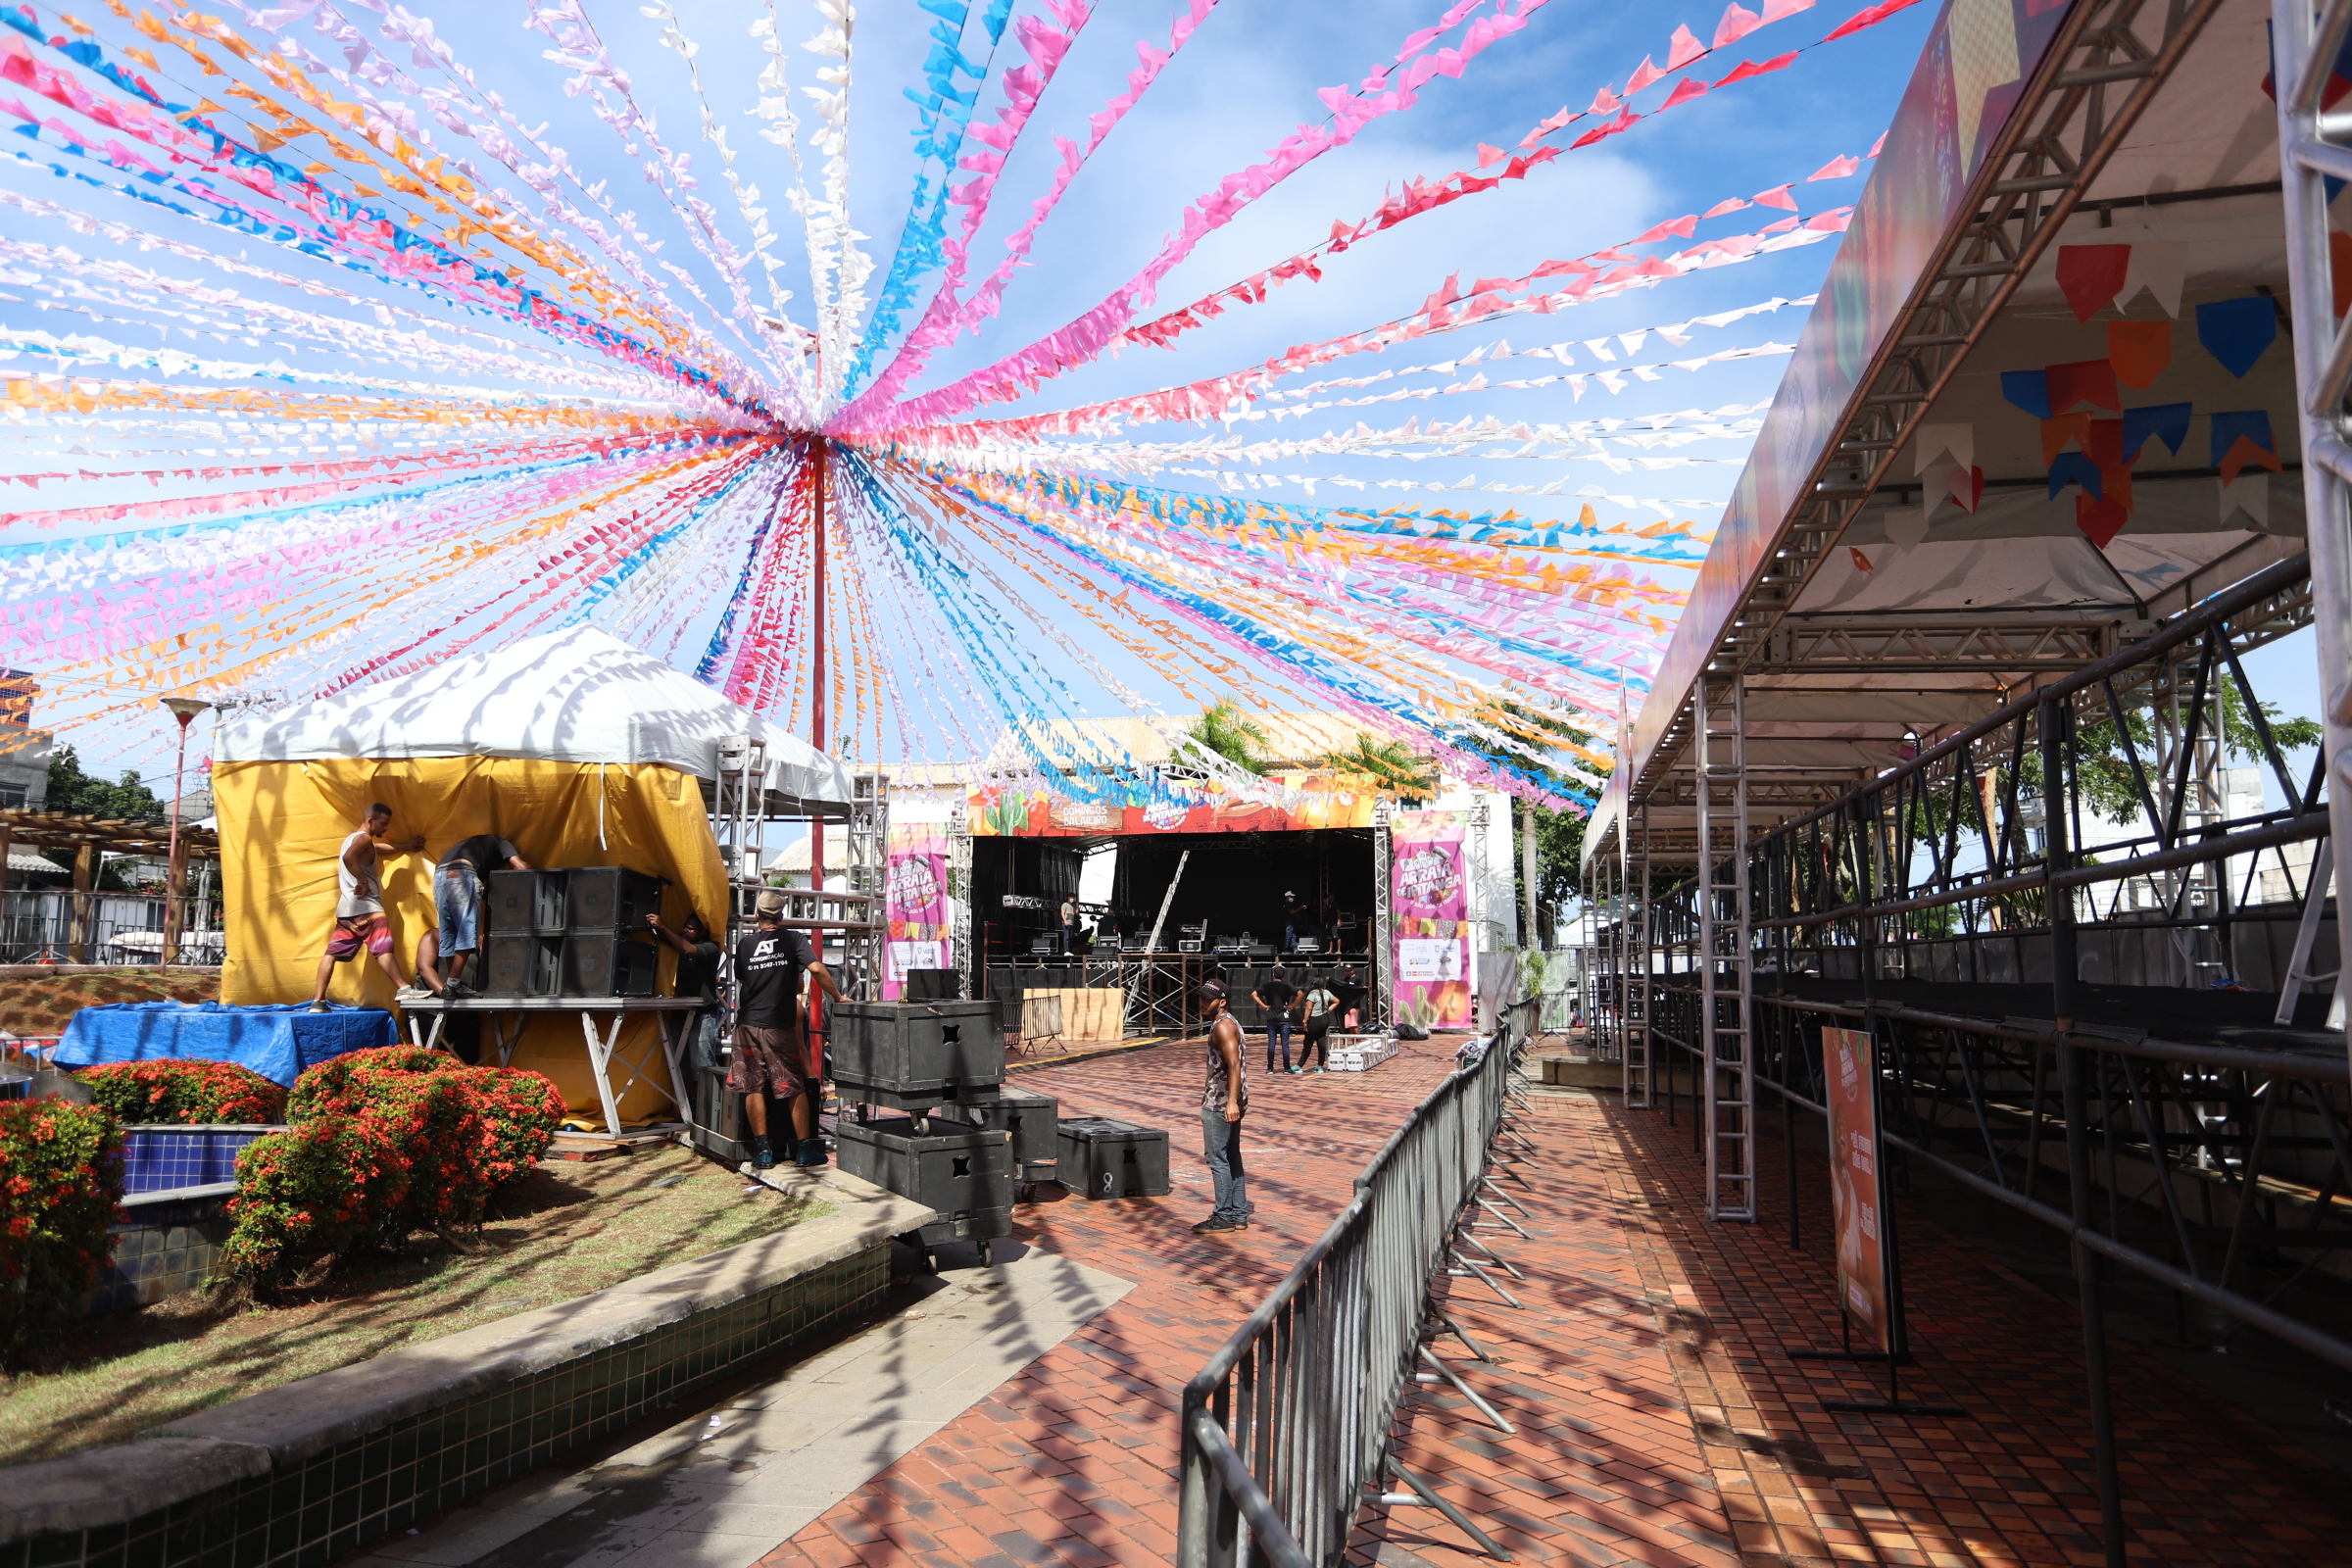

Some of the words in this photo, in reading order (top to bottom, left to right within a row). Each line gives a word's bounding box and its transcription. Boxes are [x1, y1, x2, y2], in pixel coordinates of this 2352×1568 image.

[1063, 806, 1107, 815] DOMINGOS
[1063, 815, 1107, 825] BALAIEIRO
[1399, 859, 1452, 887] ARRAIÁ
[1396, 887, 1406, 897] DE
[1405, 874, 1461, 899] IPITANGA
[754, 938, 779, 956] AT
[749, 953, 785, 963] SONORIZAÇÃO
